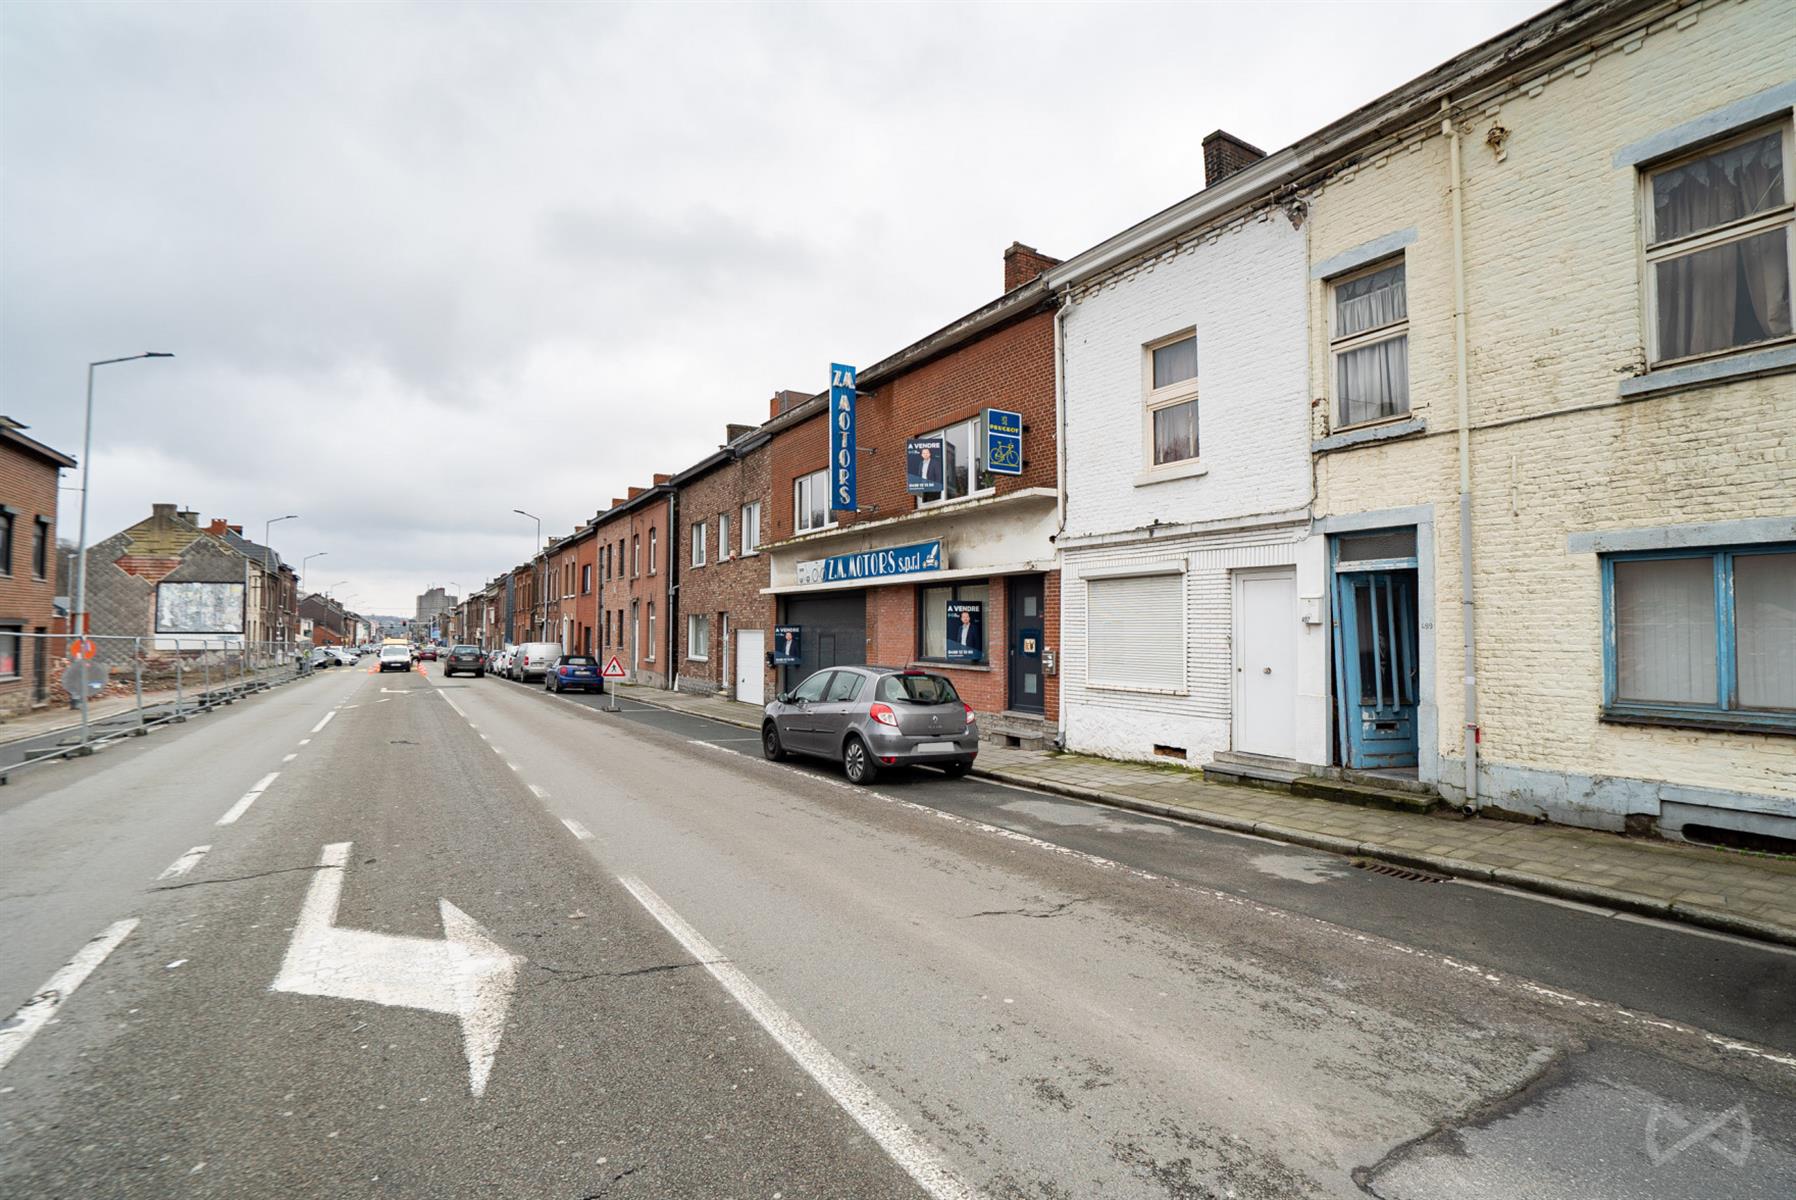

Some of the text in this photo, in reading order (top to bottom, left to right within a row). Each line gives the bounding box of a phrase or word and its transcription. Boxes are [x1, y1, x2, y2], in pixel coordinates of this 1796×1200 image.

[989, 423, 1019, 433] PEUGEOT
[838, 394, 851, 505] MOTORS
[848, 550, 896, 578] MOTORS
